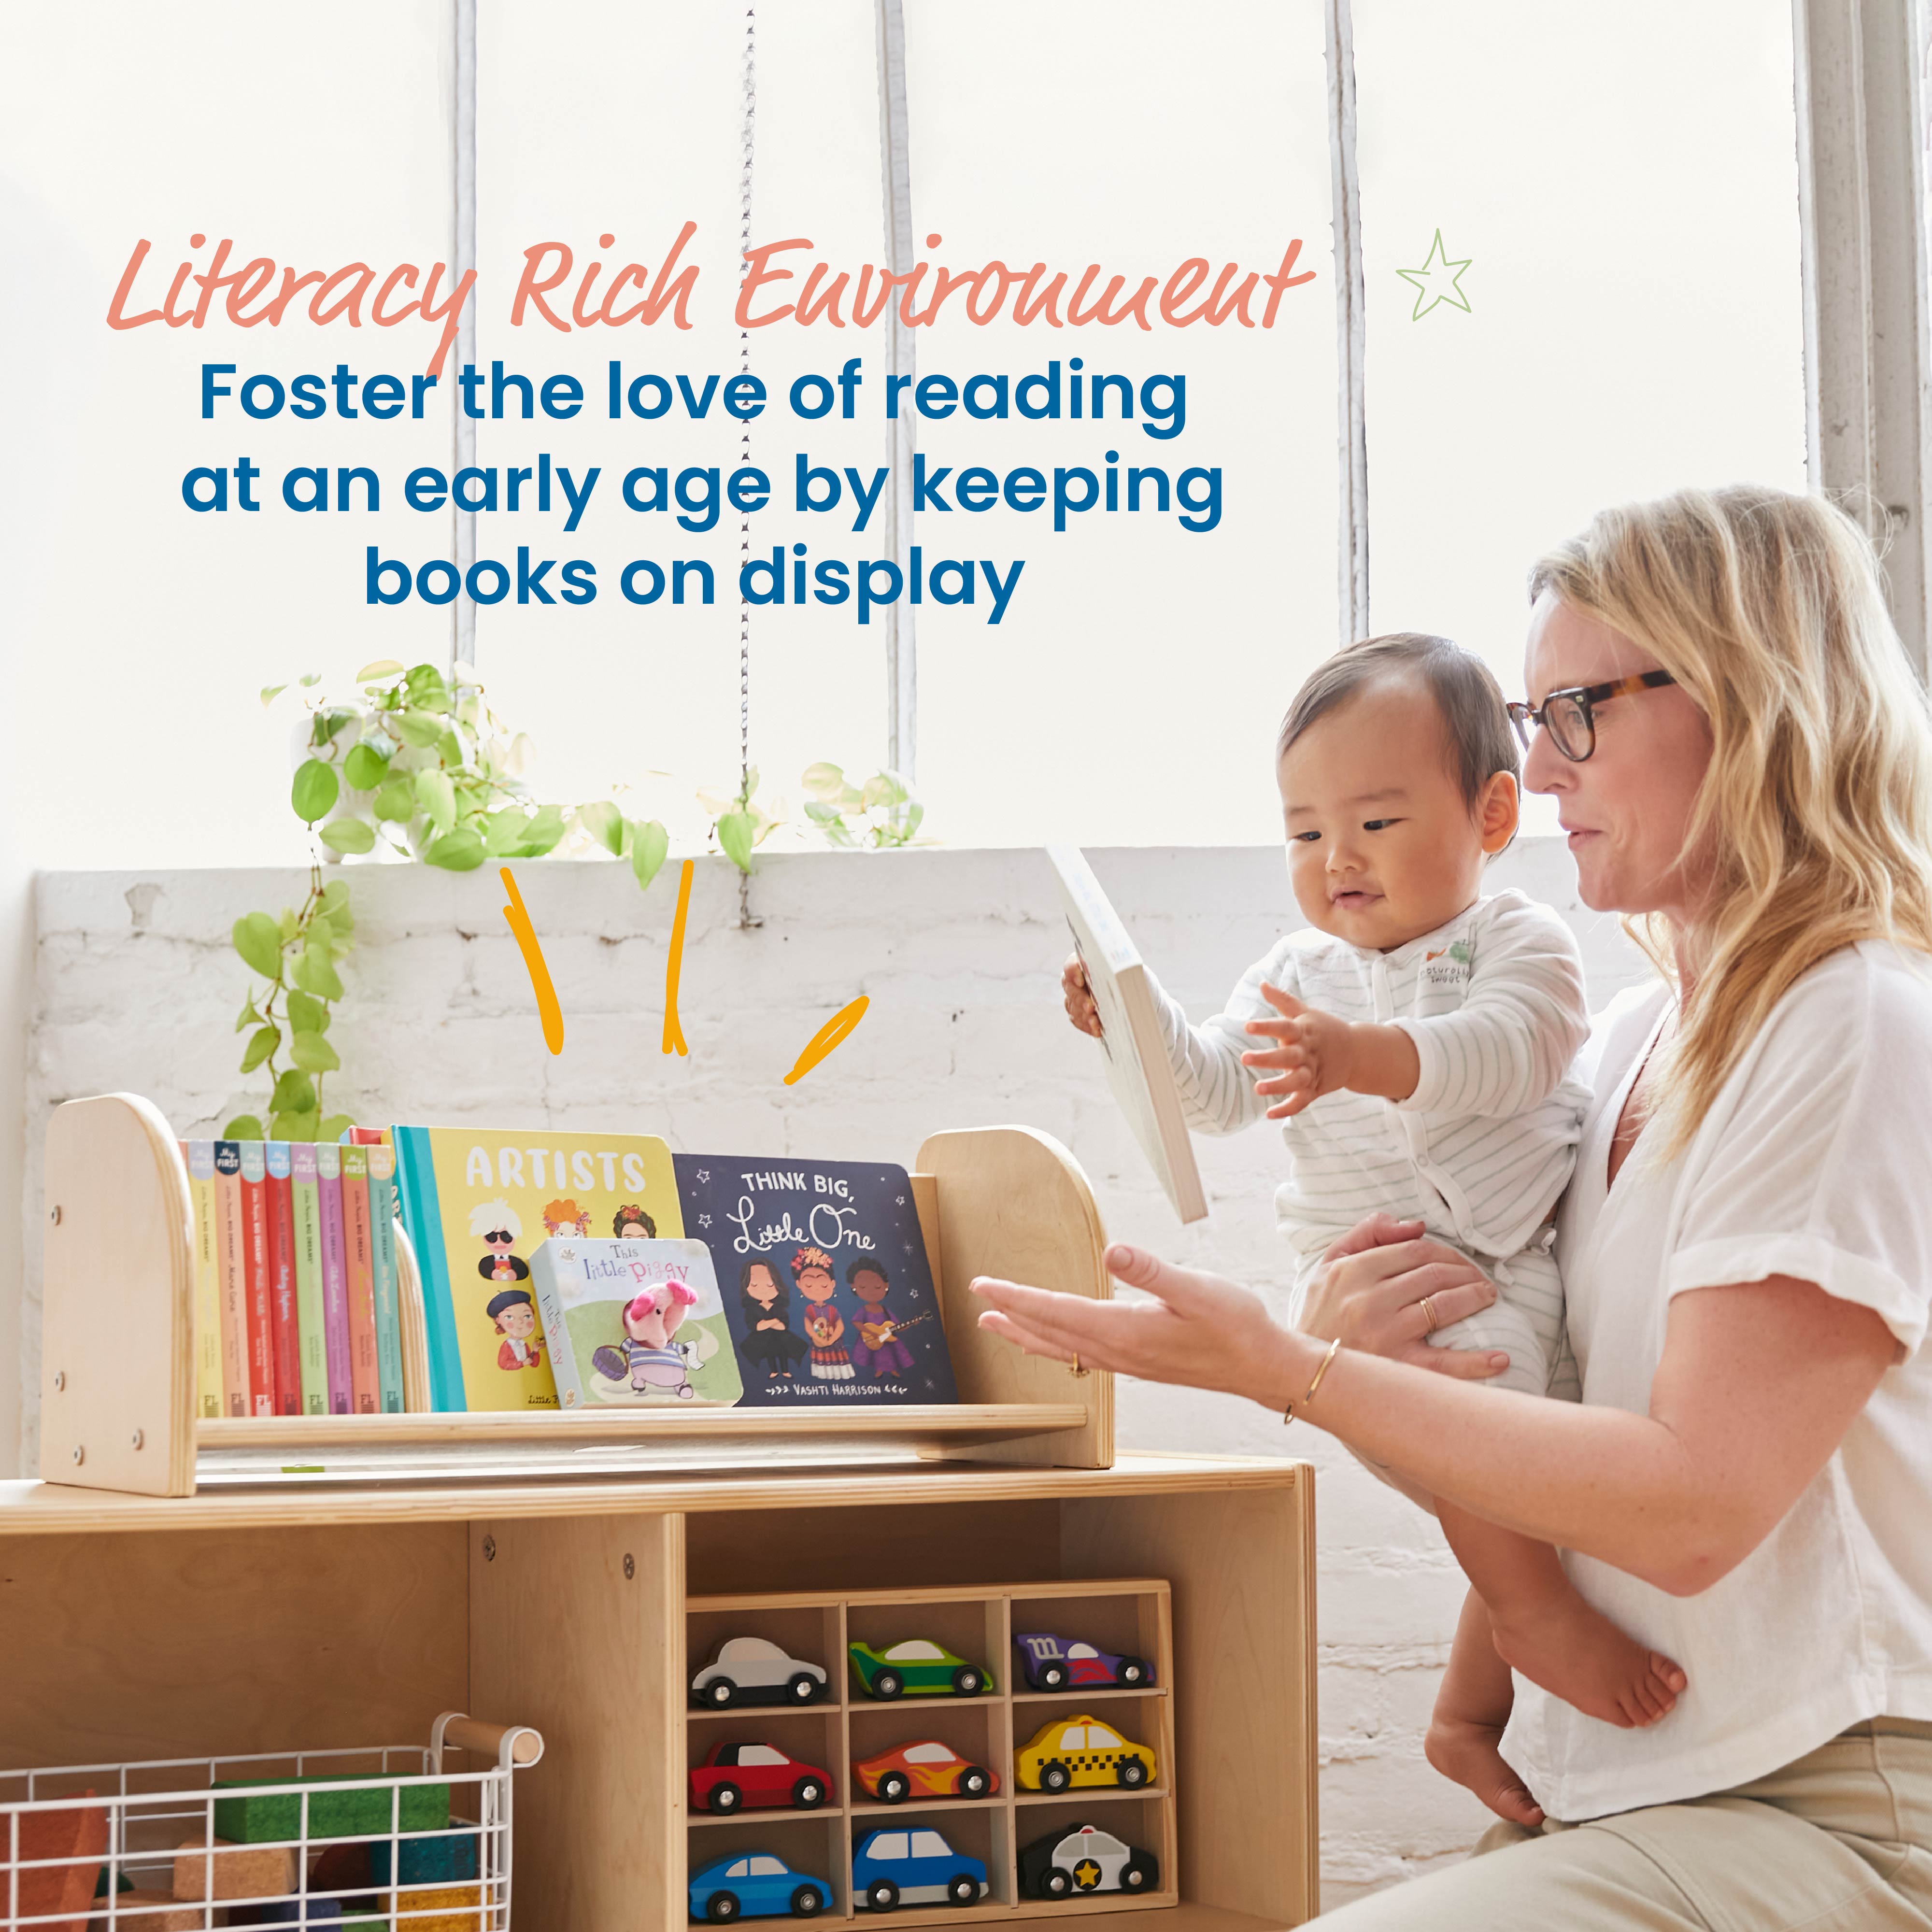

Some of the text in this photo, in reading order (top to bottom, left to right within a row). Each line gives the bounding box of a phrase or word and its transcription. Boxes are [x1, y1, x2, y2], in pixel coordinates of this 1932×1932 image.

[220, 1148, 236, 1159] My
[217, 1158, 239, 1167] FIRST
[294, 1164, 316, 1173] FIRST
[344, 1165, 367, 1173] FIRST
[466, 1146, 646, 1193] ARTISTS
[741, 1172, 854, 1203] THINK BIG,
[726, 1195, 876, 1253] Little One
[610, 1244, 639, 1259] This
[583, 1259, 626, 1280] little
[793, 1384, 881, 1396] VASHTI HARRISON
